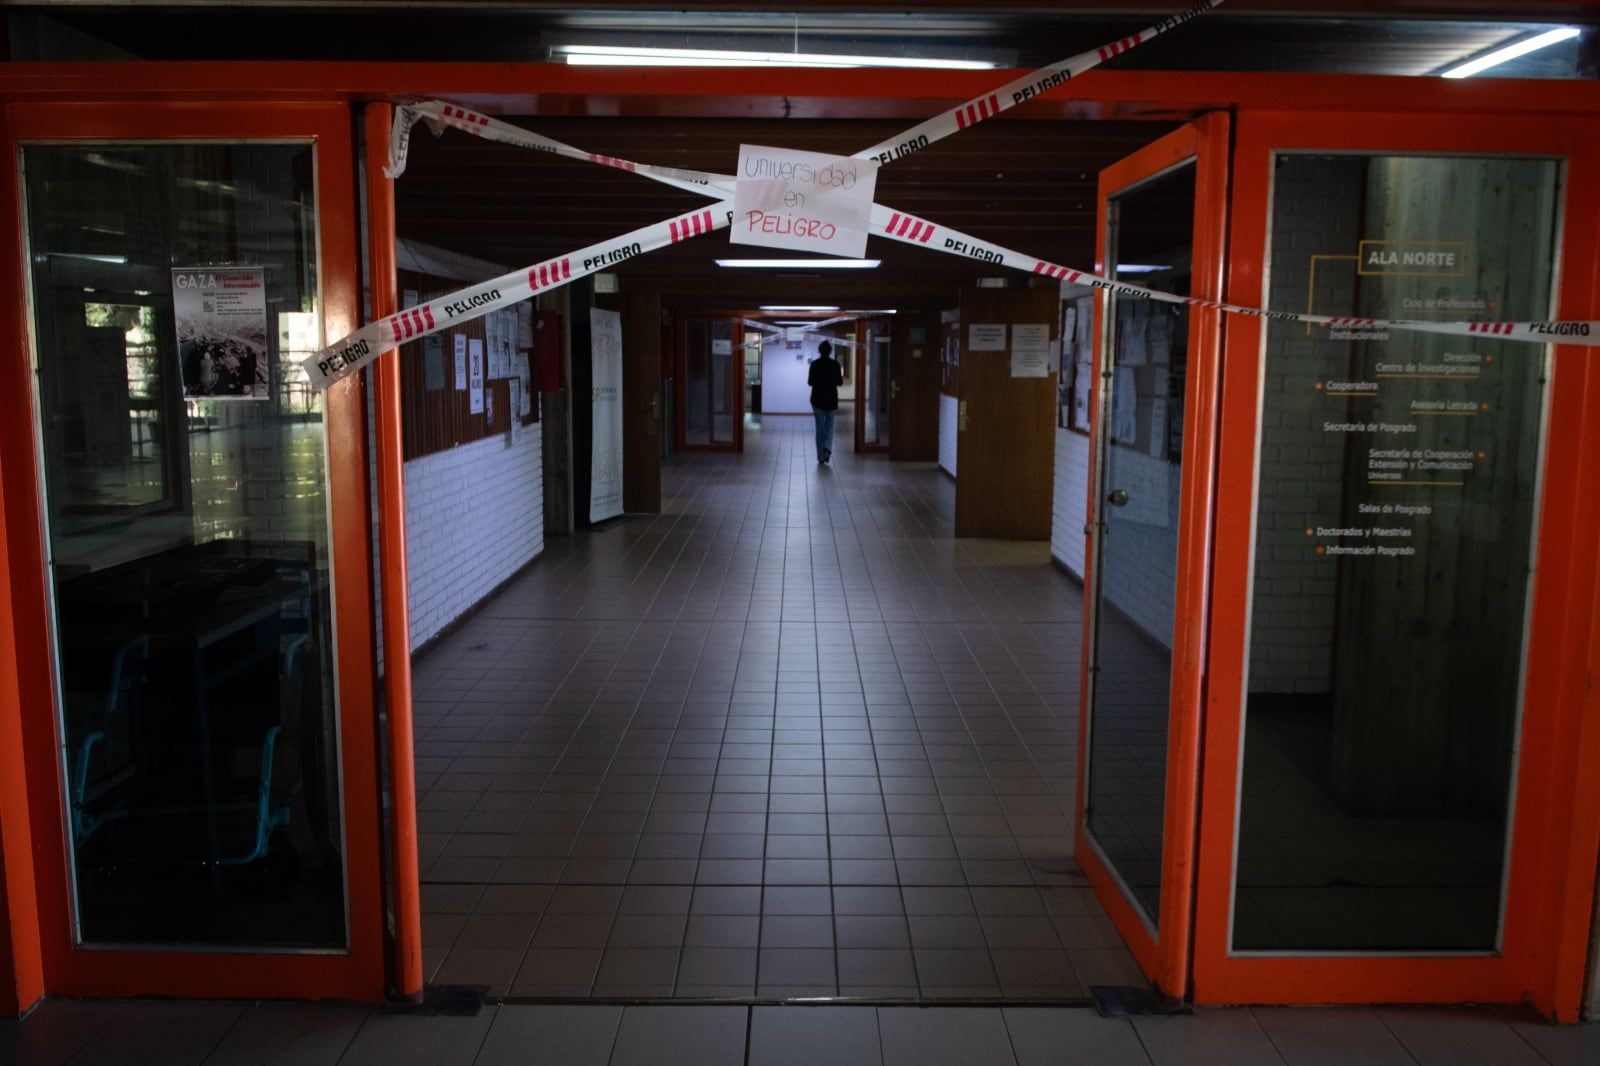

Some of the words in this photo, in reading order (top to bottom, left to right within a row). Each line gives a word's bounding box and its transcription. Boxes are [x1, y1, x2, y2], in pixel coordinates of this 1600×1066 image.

[745, 156, 857, 189] Universidad
[784, 190, 805, 209] en
[583, 242, 642, 271] PELIGRO
[1368, 251, 1398, 266] ALA
[1403, 251, 1455, 267] NORTE
[176, 273, 217, 289] GAZA
[444, 289, 502, 318] PELIGRO
[1529, 321, 1590, 337] PELIGRO
[318, 338, 370, 377] PELIGRO
[1376, 362, 1403, 374] Centro
[1405, 363, 1416, 374] de
[1326, 380, 1378, 393] Cooperadora
[1367, 422, 1378, 433] de
[1380, 422, 1417, 435] Posgrado
[1412, 449, 1423, 460] de
[1358, 503, 1381, 514] Salas
[1382, 504, 1393, 515] de
[1395, 504, 1432, 516] Posgrado
[1316, 526, 1363, 538] Doctorados
[1377, 545, 1416, 558] Posgrado
